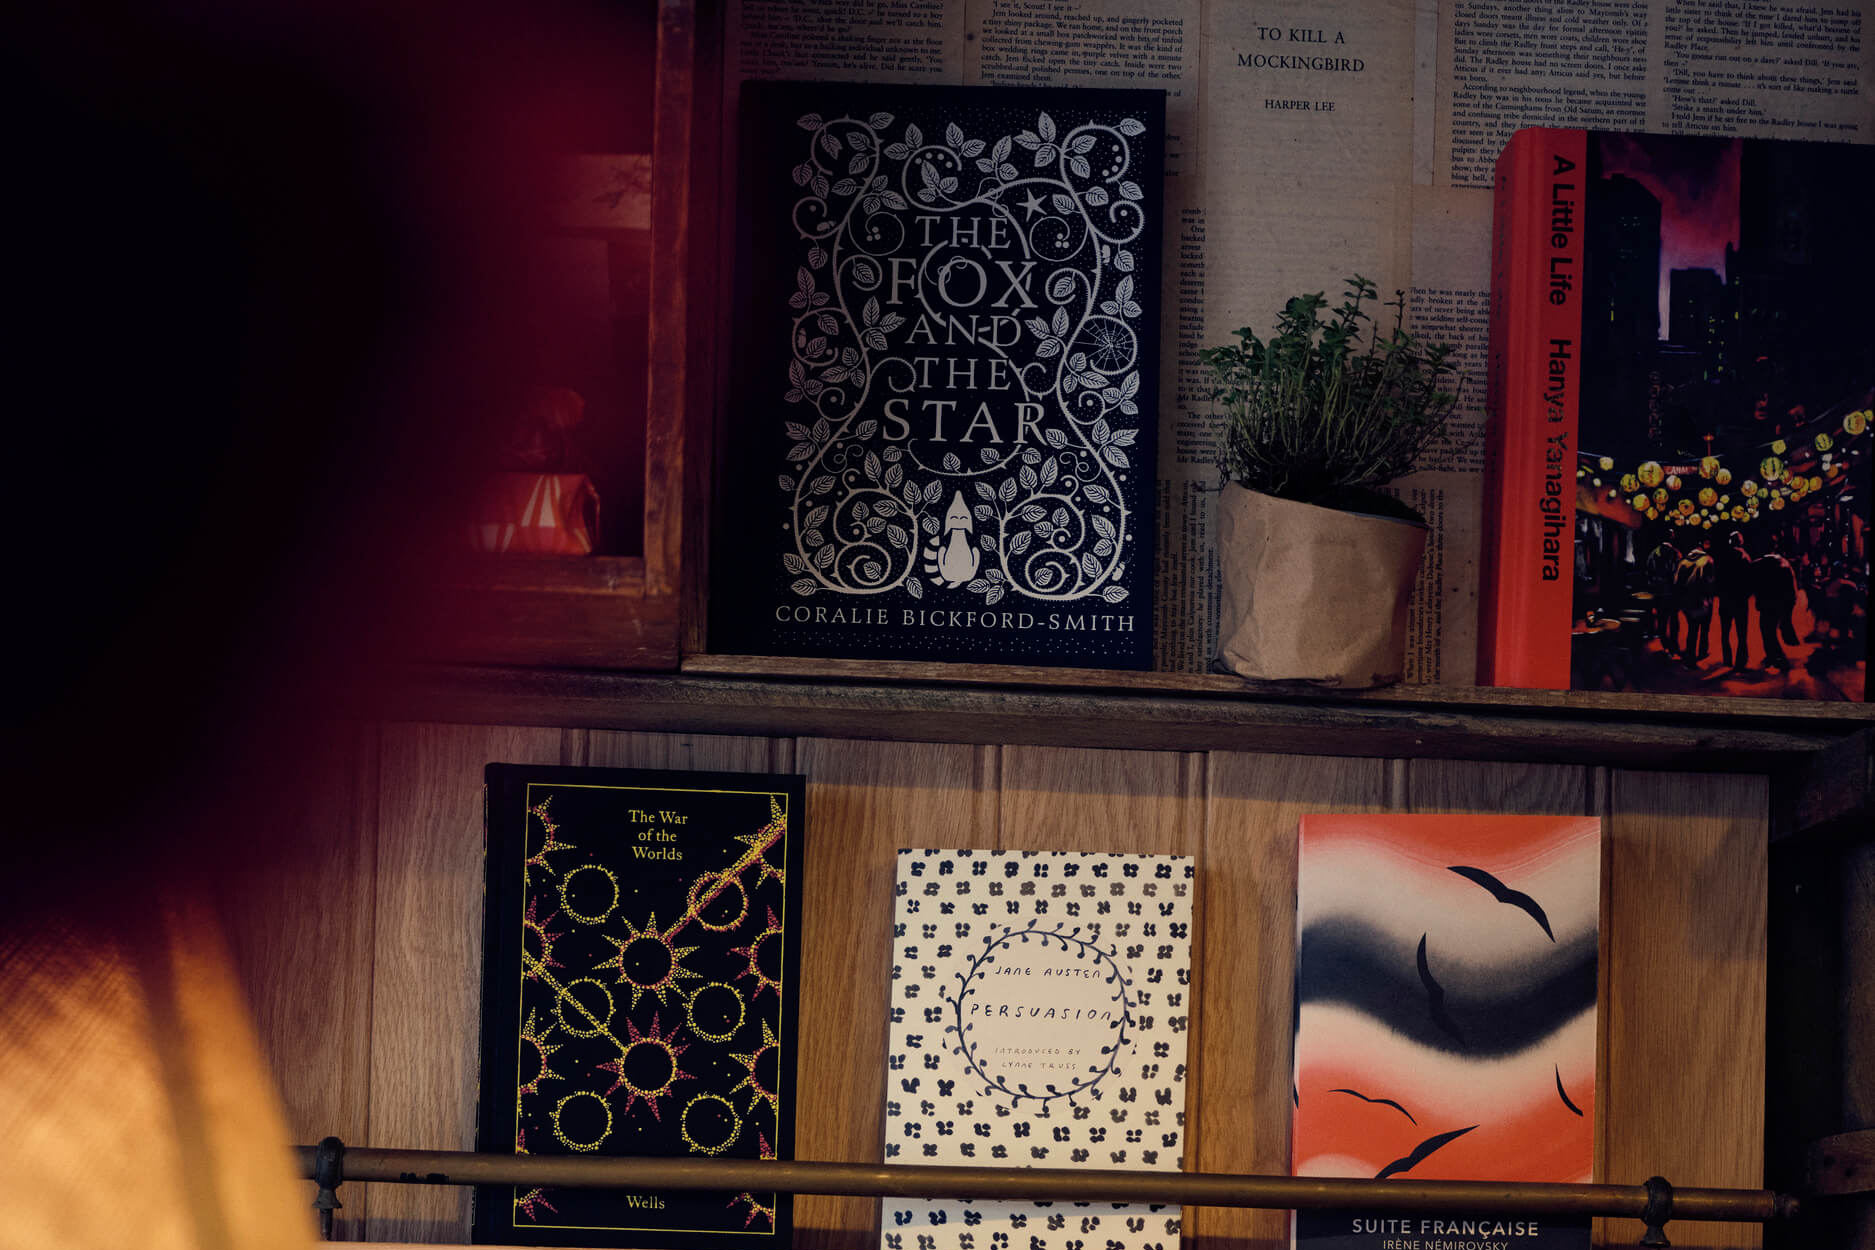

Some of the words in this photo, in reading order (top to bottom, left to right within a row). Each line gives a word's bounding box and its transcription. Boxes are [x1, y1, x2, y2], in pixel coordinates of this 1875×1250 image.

[1008, 10, 1031, 18] looked
[1257, 27, 1281, 41] TO
[1289, 28, 1327, 43] KILL
[1334, 31, 1345, 44] A
[1237, 53, 1365, 72] MOCKINGBIRD
[1736, 71, 1753, 80] think
[1509, 84, 1560, 95] neighbourhood
[1265, 99, 1310, 111] HARPER
[1315, 101, 1336, 112] LEE
[1553, 155, 1576, 174] A
[1551, 182, 1576, 248] Little
[915, 216, 1011, 249] THE
[888, 256, 1039, 309] FOX
[1549, 256, 1574, 306] Life
[1455, 289, 1475, 297] nearly
[905, 313, 1022, 347] AND
[914, 357, 1012, 391] THE
[1542, 339, 1572, 424] Hanya
[882, 399, 1050, 447] STAR
[1539, 428, 1570, 582] Yanagihara
[775, 606, 889, 626] CORALIE
[903, 609, 1135, 633] BICKFORD-SMITH
[628, 809, 658, 824] The
[661, 811, 689, 825] War
[638, 828, 652, 843] of
[655, 829, 678, 843] the
[632, 845, 684, 862] Worlds
[995, 967, 1032, 977] JANE
[1043, 967, 1101, 979] AUSTEN
[970, 1004, 1112, 1022] PERSUASION
[626, 1195, 666, 1210] Wells
[1352, 1218, 1412, 1235] SUITE
[1420, 1219, 1540, 1239] FRANÇAISE
[1383, 1239, 1421, 1250] IRÈNE
